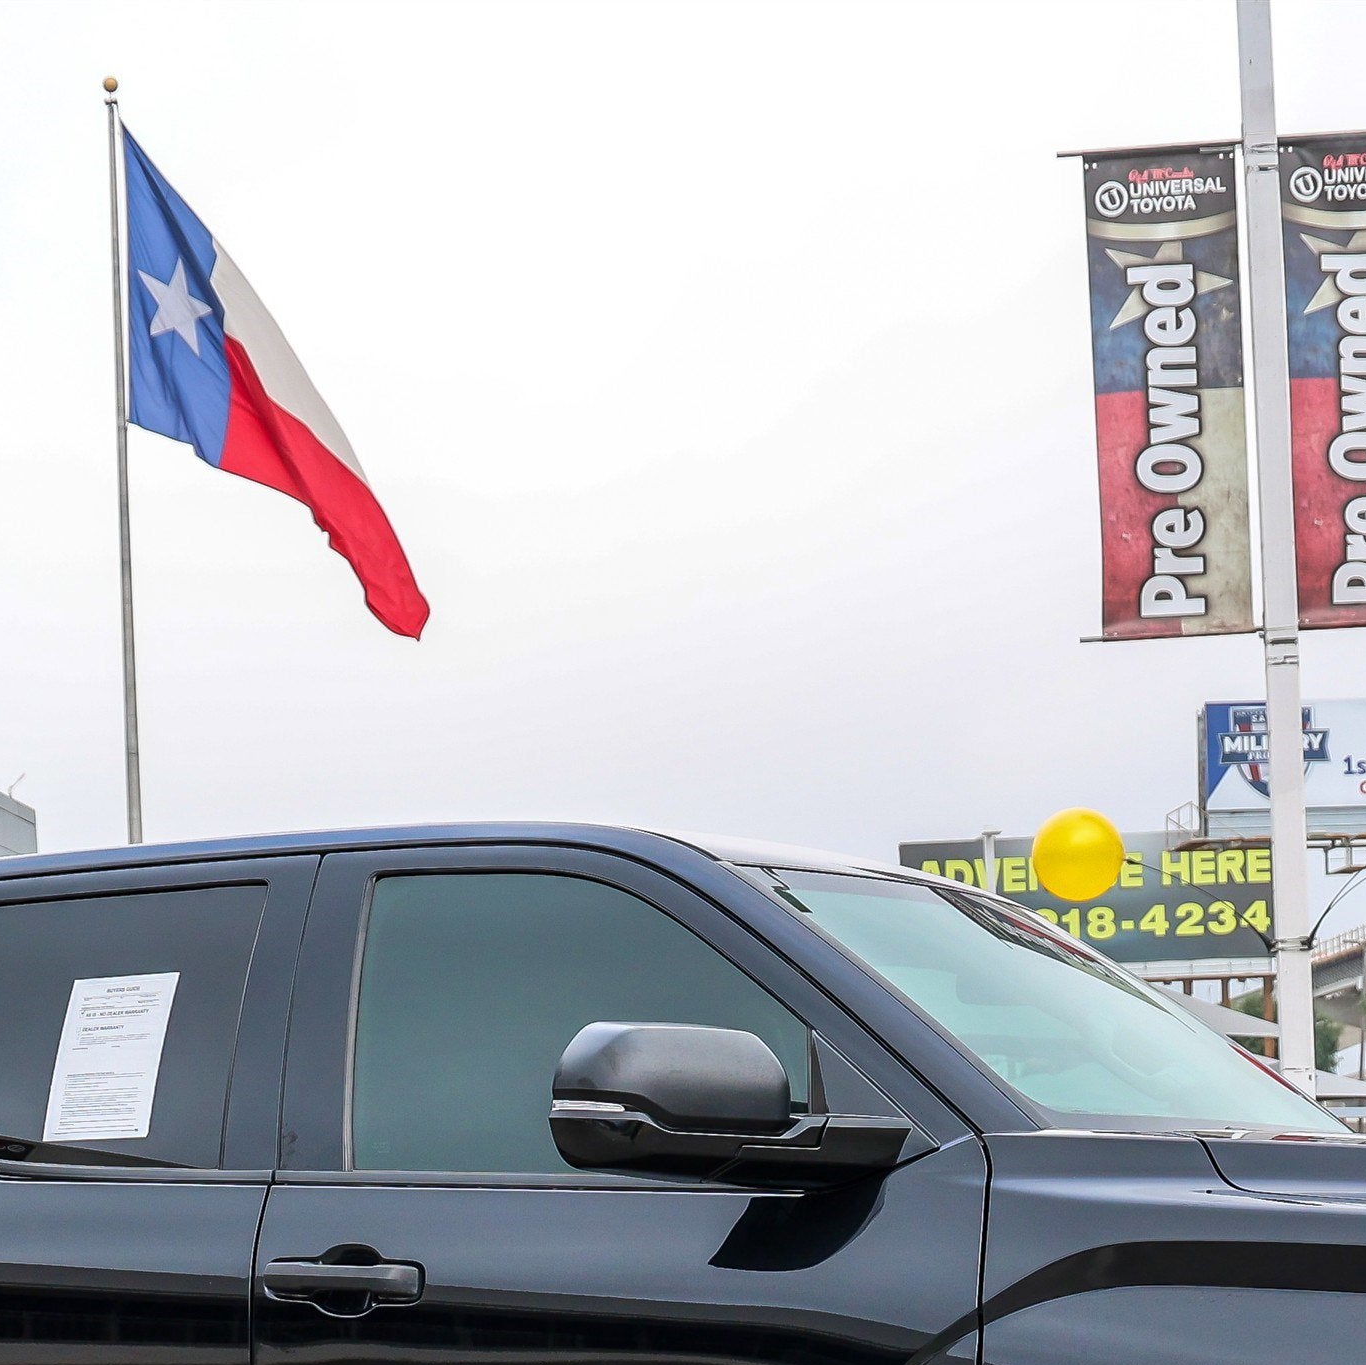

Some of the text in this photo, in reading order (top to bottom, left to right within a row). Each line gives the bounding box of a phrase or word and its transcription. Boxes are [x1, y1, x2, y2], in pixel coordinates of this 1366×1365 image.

[1129, 177, 1227, 199] UNIVERSAL
[1130, 194, 1197, 214] TOYOTA
[1126, 263, 1206, 619] Pre Owned
[1162, 849, 1271, 886] HERE
